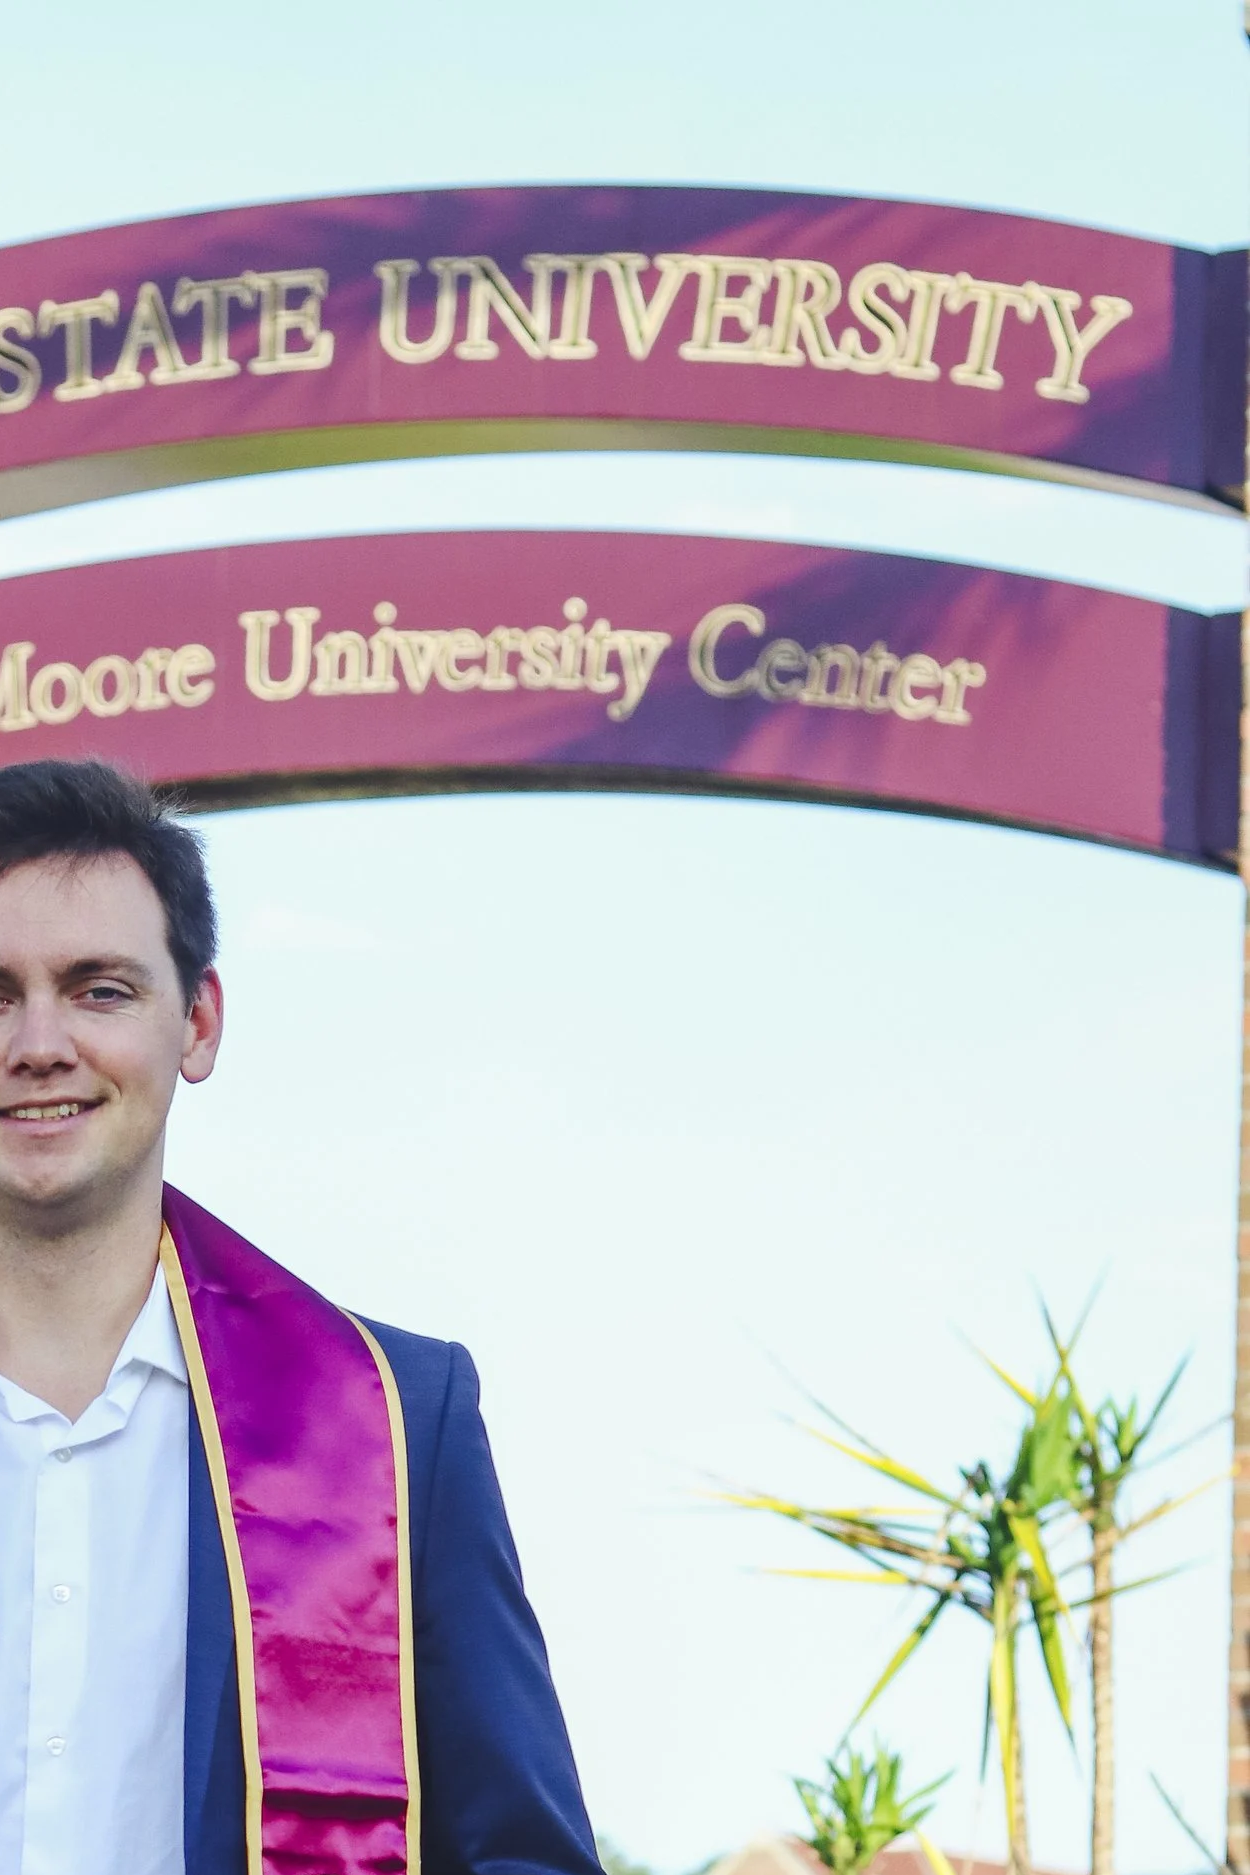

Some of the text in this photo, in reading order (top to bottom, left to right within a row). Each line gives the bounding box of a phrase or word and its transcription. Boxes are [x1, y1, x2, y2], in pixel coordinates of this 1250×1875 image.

[375, 252, 1133, 404] UNIVERSITY
[239, 597, 670, 721] University
[687, 603, 987, 725] Center
